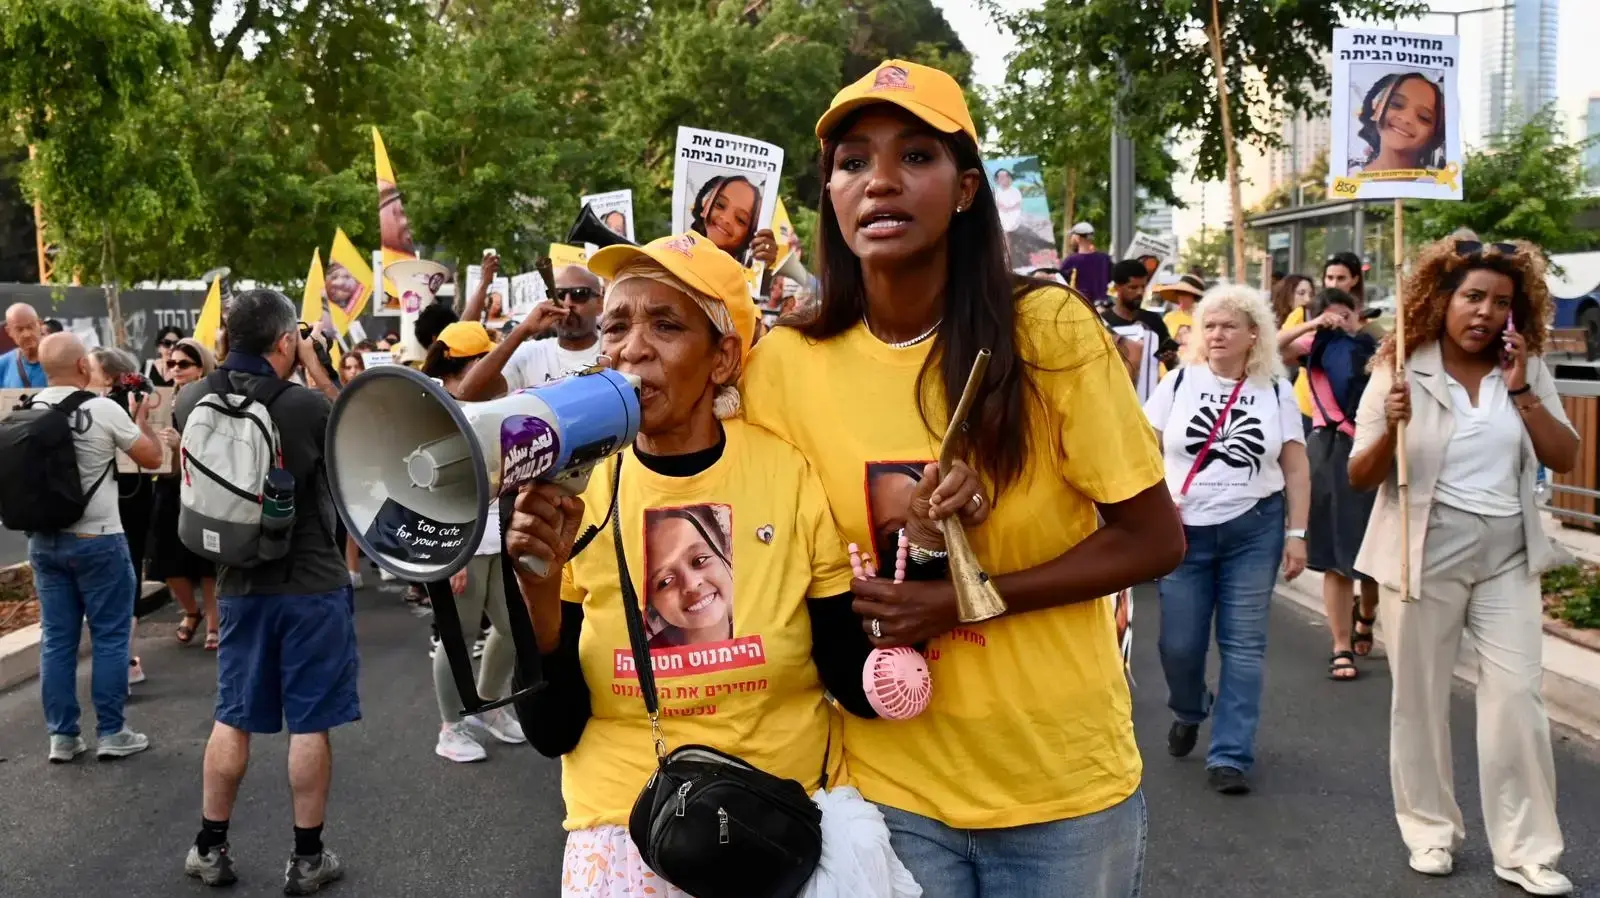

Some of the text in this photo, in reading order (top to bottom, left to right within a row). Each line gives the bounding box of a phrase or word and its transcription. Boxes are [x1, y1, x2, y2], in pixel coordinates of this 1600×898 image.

[1352, 34, 1443, 51] מחזירים את
[1340, 49, 1454, 67] היימנוט הביתה
[692, 134, 769, 157] מחזירים את
[681, 147, 777, 172] היימנוט הביתה
[1335, 181, 1357, 194] 850
[396, 524, 463, 547] for your wars
[417, 519, 460, 536] too cute
[616, 643, 761, 671] היימנוט חטוה!
[611, 679, 768, 699] מחזירים את המנוט
[663, 703, 717, 717] עכשיו!
